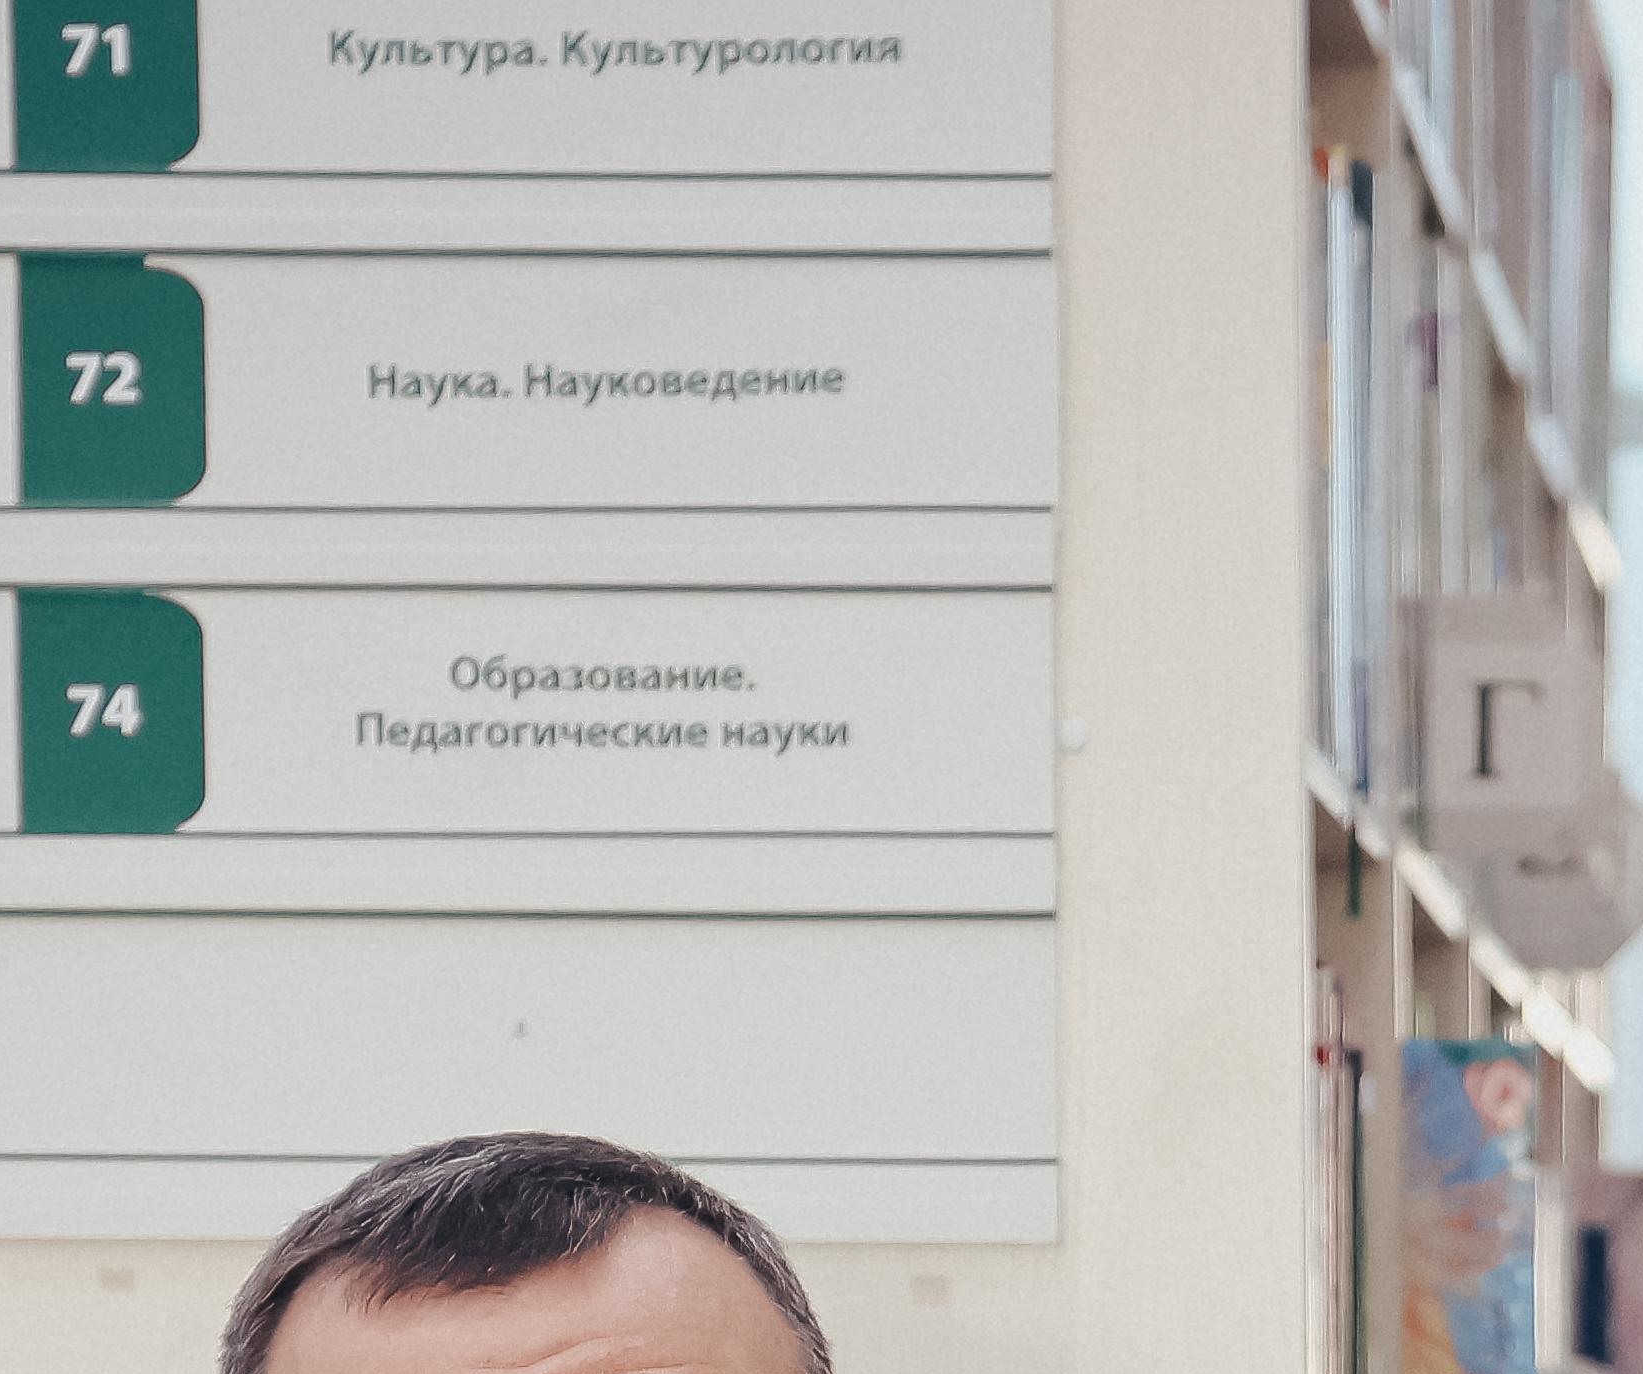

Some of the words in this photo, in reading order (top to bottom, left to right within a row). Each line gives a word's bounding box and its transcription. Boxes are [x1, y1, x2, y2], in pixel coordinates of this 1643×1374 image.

[61, 22, 132, 77] 71
[328, 30, 547, 75] Культура.
[562, 30, 902, 76] Культурология
[65, 350, 143, 406] 72
[368, 362, 511, 407] Наука.
[524, 361, 845, 407] Науковедение
[449, 654, 756, 700] Образование.
[65, 682, 143, 738] 74
[356, 711, 708, 754] Педагогические
[722, 719, 851, 757] науки
[1469, 677, 1547, 783] Г
